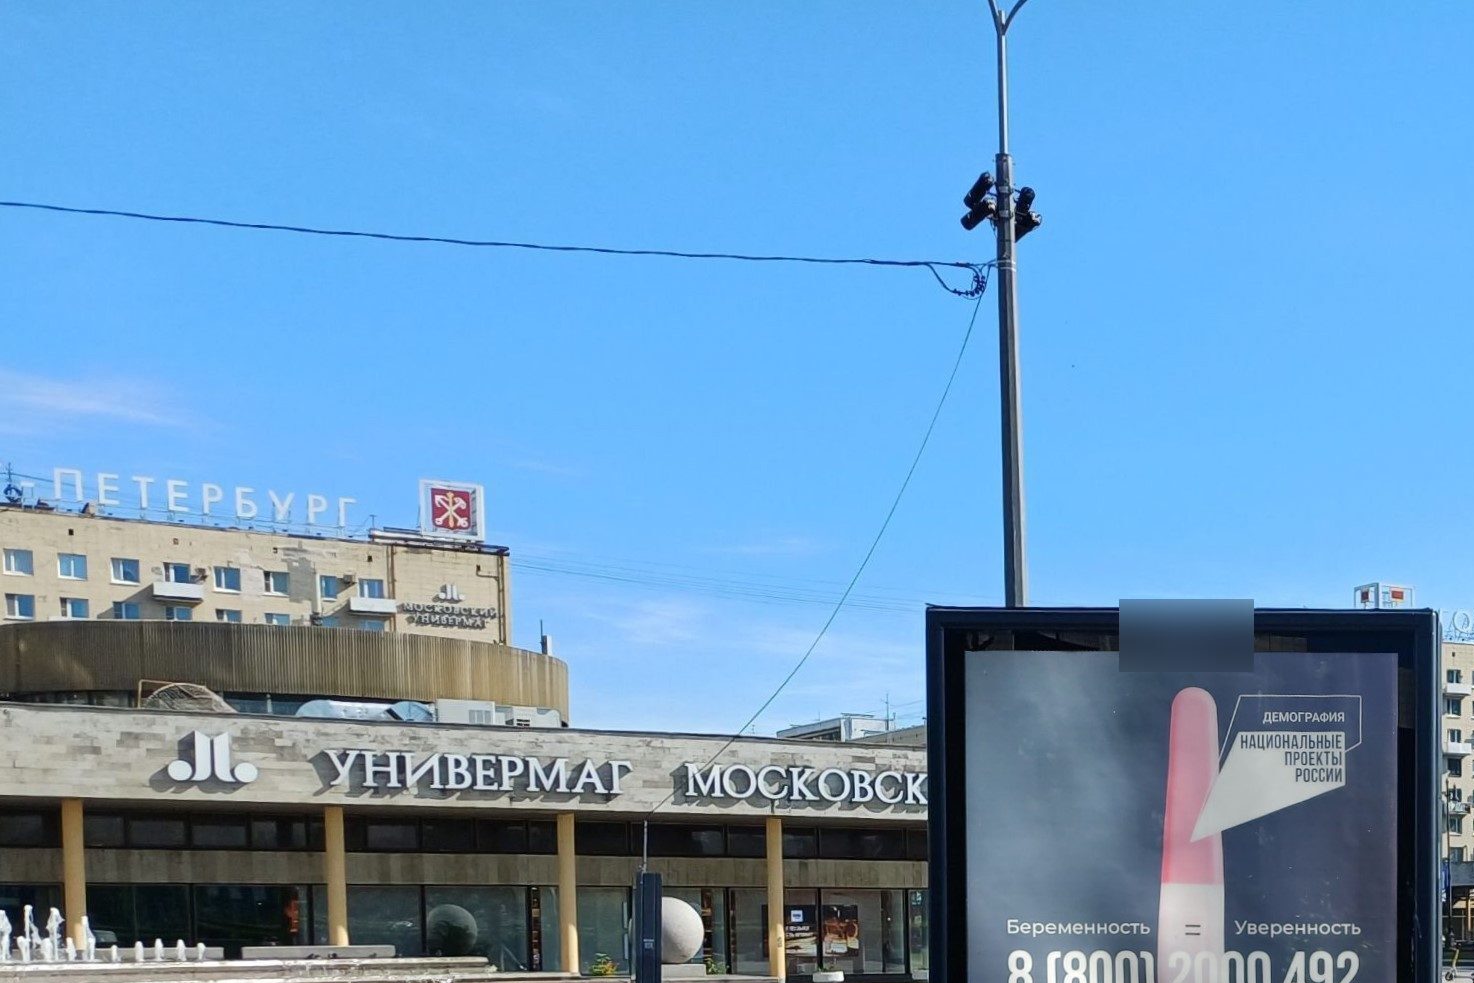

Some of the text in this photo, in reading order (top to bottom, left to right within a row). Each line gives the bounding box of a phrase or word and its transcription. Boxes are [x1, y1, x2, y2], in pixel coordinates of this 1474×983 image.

[403, 602, 498, 618] МОСКОВСКИЙ
[1263, 711, 1345, 724] ДЕМОГРАФИЯ
[1240, 734, 1342, 751] НАЦИОНАЛЬНЫЕ
[1284, 751, 1342, 766] ПРОЕКТЫ
[324, 749, 633, 794] УНИВЕРМАГ
[1295, 768, 1342, 782] РОССИИ
[1006, 919, 1151, 937] Беременность
[1234, 919, 1362, 937] Уверенность
